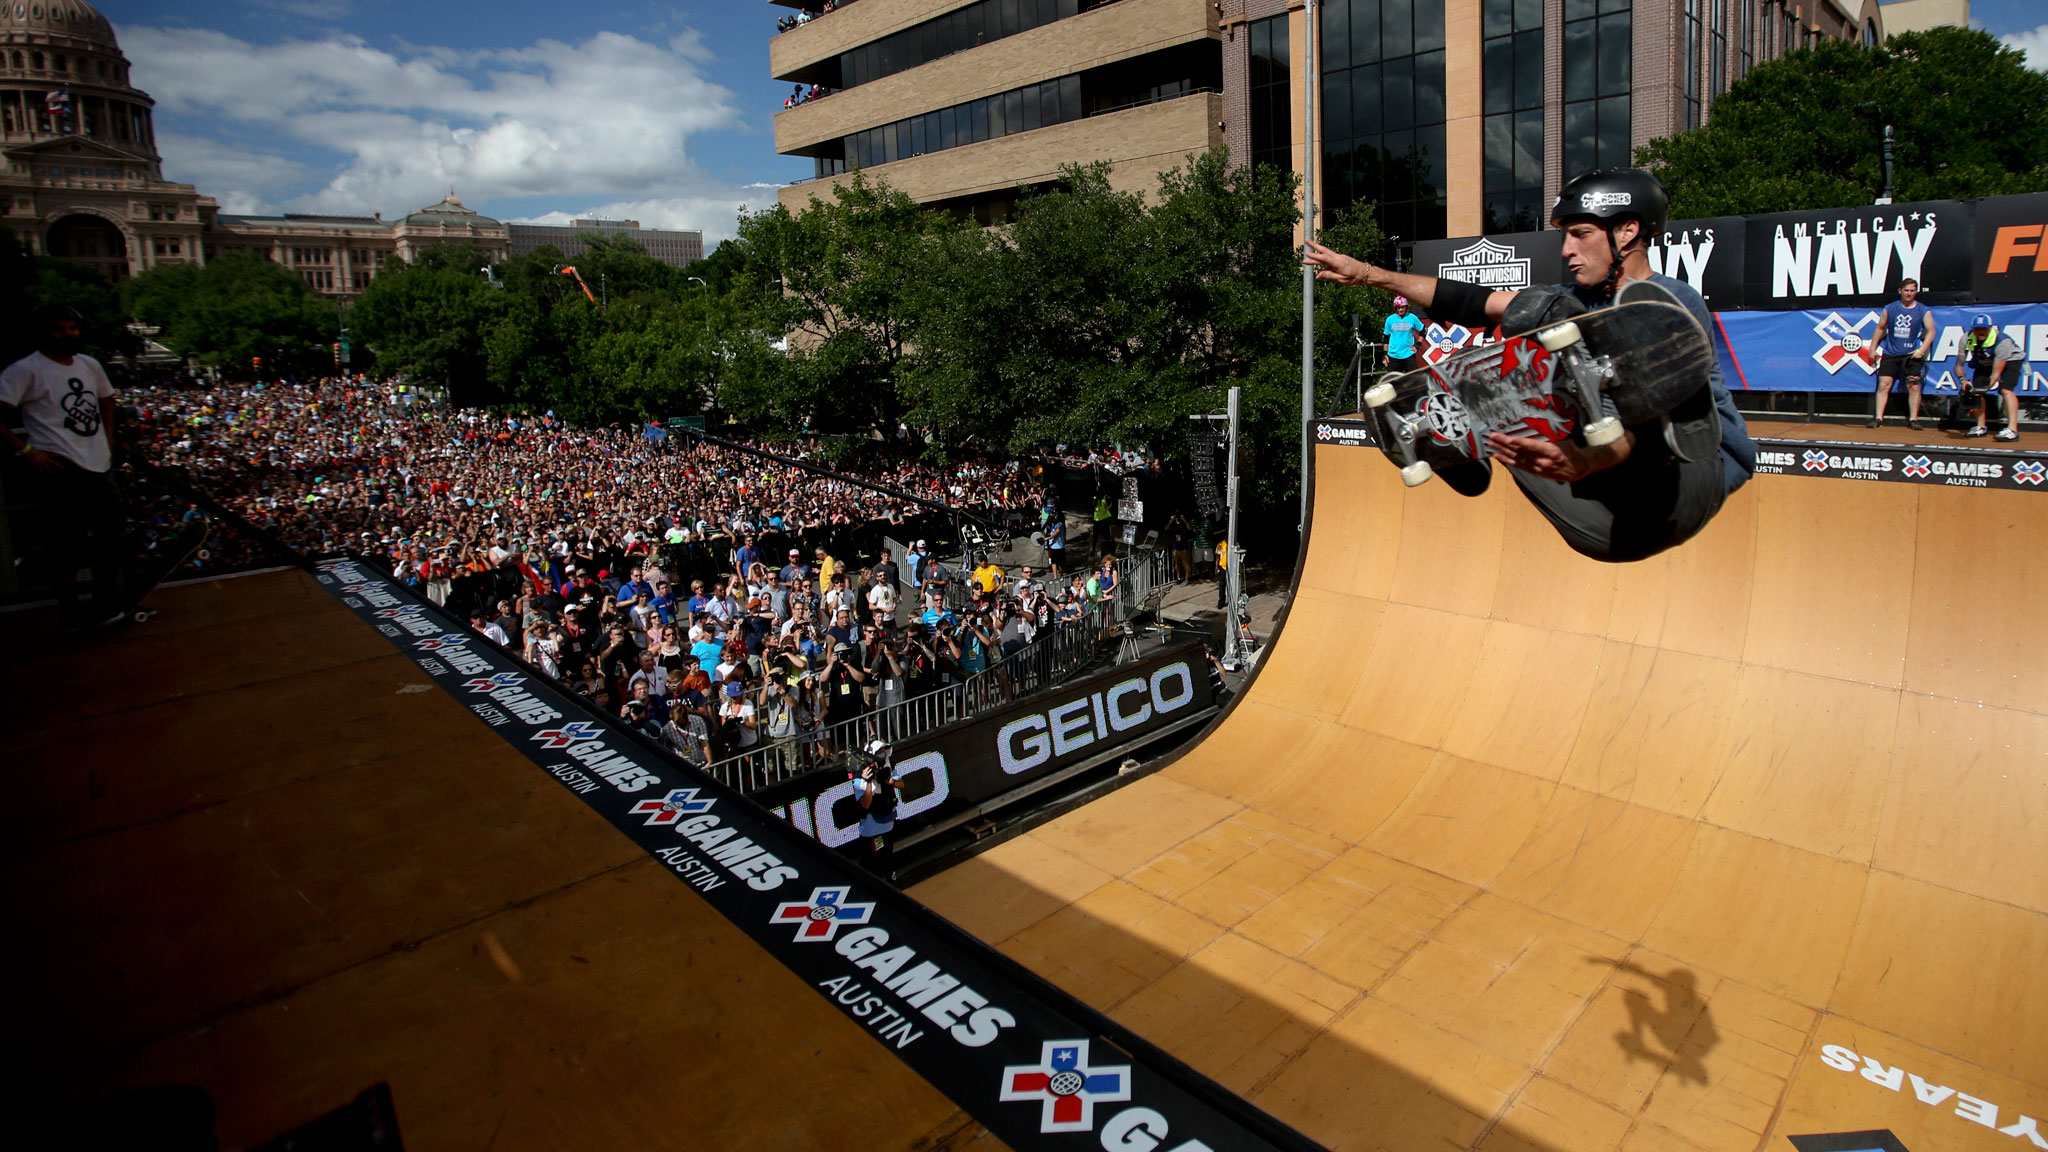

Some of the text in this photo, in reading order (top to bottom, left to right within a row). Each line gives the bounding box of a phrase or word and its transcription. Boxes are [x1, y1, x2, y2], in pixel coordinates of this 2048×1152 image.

[1463, 250, 1504, 266] MOTOR
[1772, 227, 1938, 298] NAVY
[1446, 266, 1522, 284] HARLEY-DAVIDSON
[1332, 428, 1367, 440] GAMES
[1829, 455, 1893, 472] GAMES
[1932, 460, 2003, 478] GAMES
[1842, 470, 1879, 481] AUSTIN
[1946, 477, 1987, 487] AUSTIN
[392, 613, 443, 637] GAMES
[416, 657, 449, 677] AUSTIN
[435, 644, 495, 675] GAMES
[470, 702, 513, 728] AUSTIN
[488, 686, 563, 725] GAMES
[997, 660, 1194, 775] GEICO
[546, 763, 601, 795] AUSTIN
[566, 741, 661, 793] GAMES
[674, 813, 799, 892] GAMES
[654, 846, 726, 893] AUSTIN
[834, 926, 1016, 1048] GAMES
[819, 975, 924, 1049] AUSTIN
[1820, 1044, 2048, 1151] YEARS
